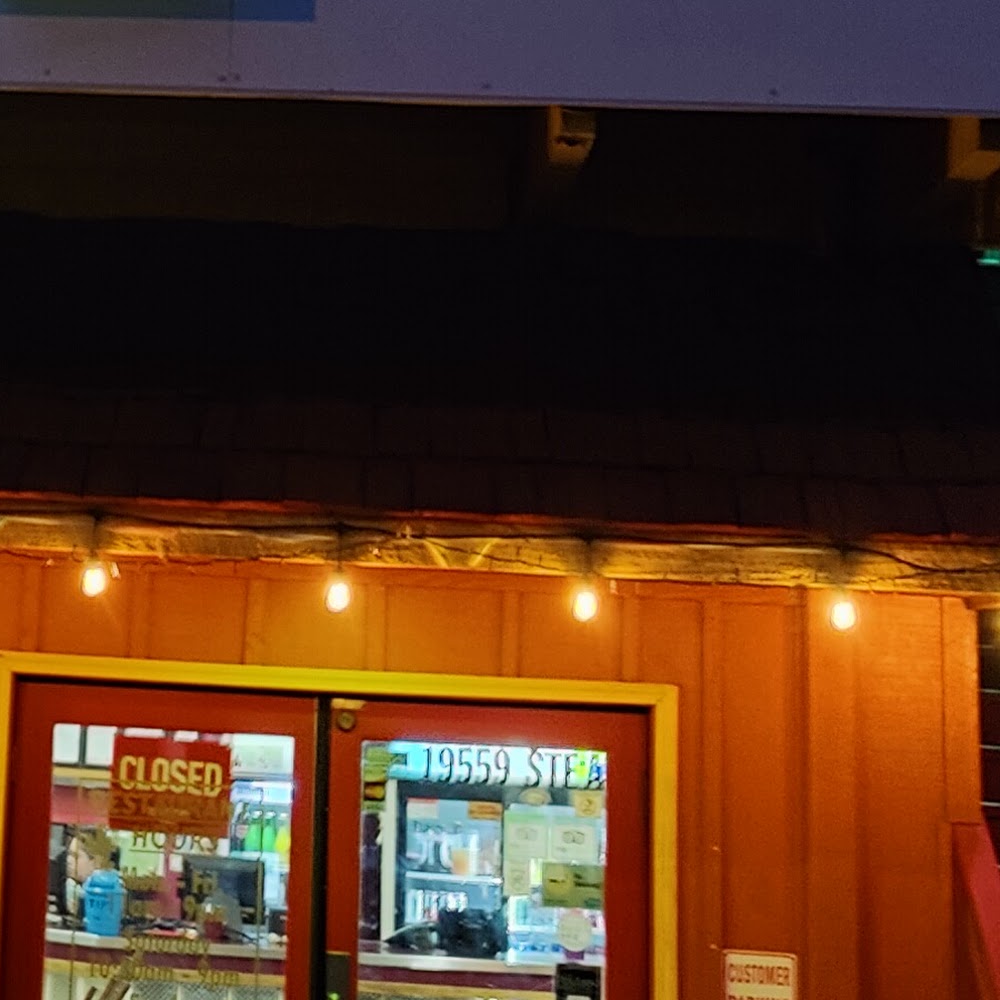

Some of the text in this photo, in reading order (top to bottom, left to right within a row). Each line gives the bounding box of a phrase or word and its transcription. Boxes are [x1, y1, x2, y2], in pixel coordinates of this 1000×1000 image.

[119, 755, 223, 798] CLOSED
[422, 746, 511, 786] 19559
[526, 748, 578, 790] STE
[728, 963, 790, 987] CUSTOMER
